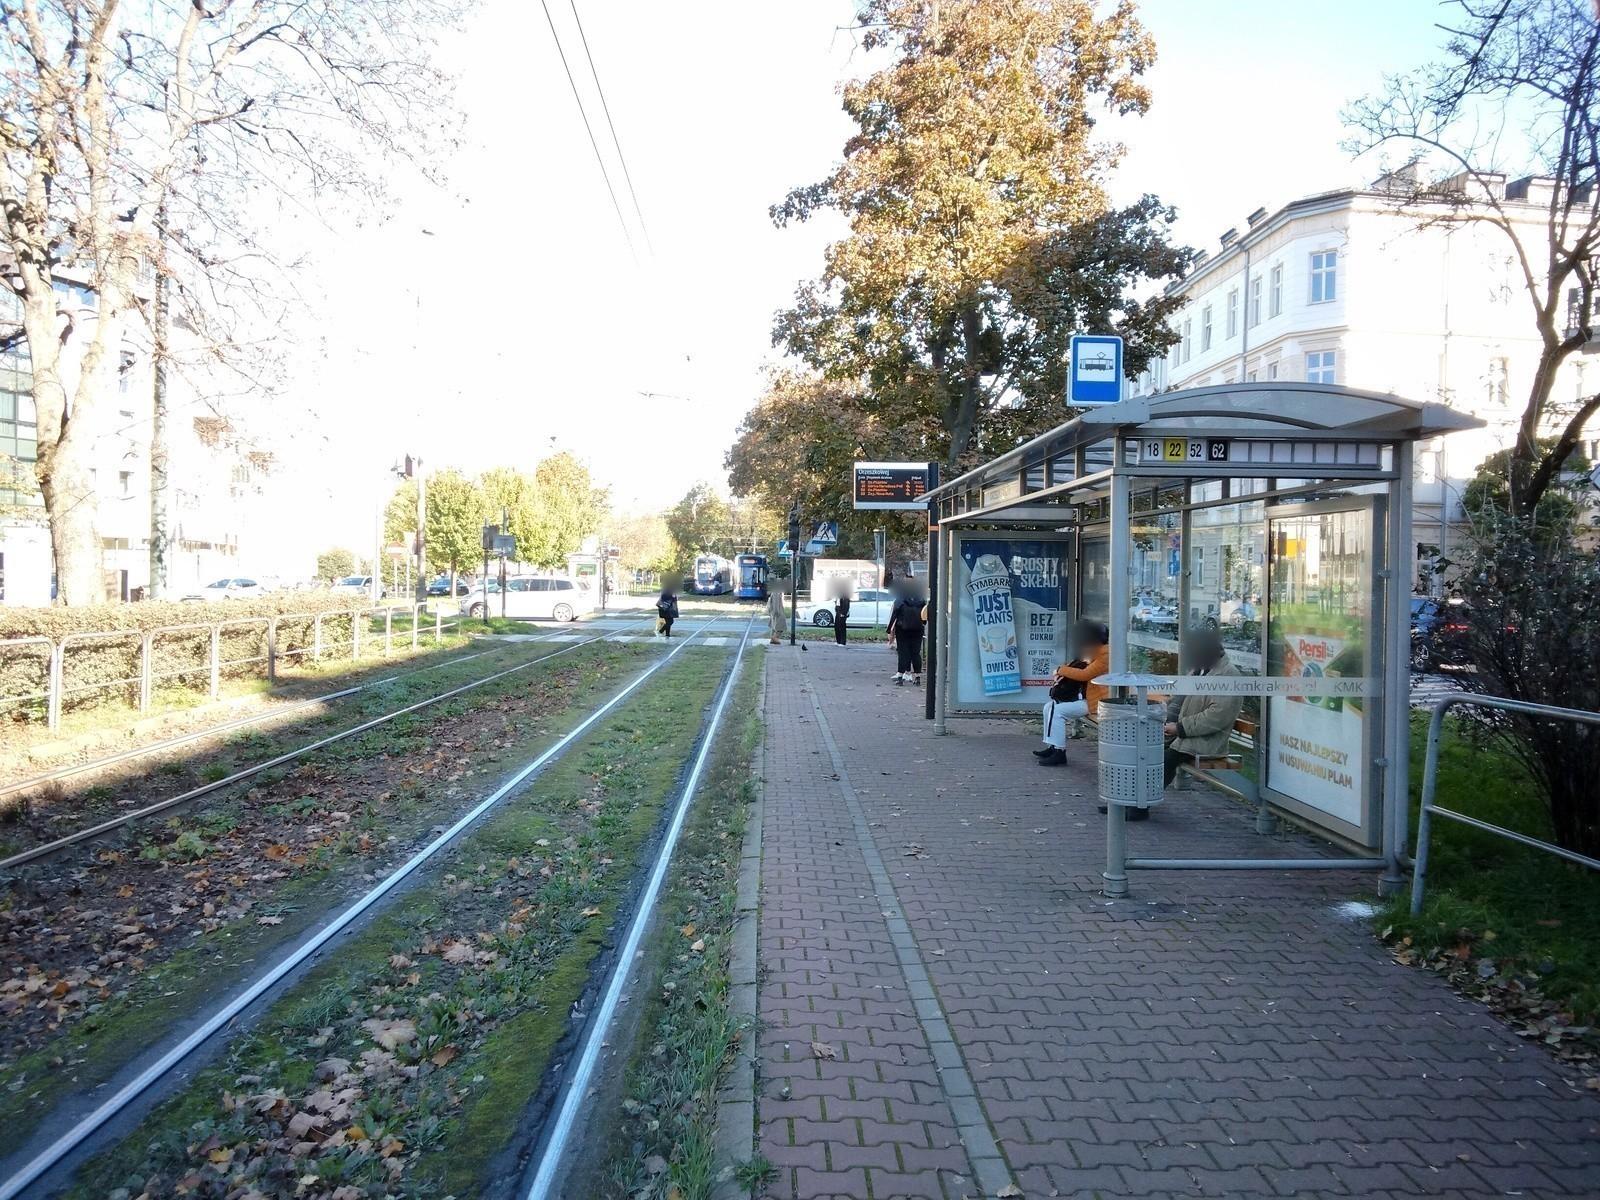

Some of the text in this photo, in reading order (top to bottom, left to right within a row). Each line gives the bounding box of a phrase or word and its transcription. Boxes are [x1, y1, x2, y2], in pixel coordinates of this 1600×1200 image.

[1148, 443, 1224, 458] 18 22 52 62
[970, 577, 1011, 592] TYMBARK
[1021, 574, 1058, 587] SKŁAD
[976, 594, 1010, 613] JUST
[976, 610, 1013, 626] PLANTS
[1030, 613, 1053, 627] BEZ
[1029, 633, 1054, 641] CUKRU
[1299, 638, 1327, 659] Persil
[986, 661, 1015, 673] OWIES
[1334, 681, 1364, 693] KMK
[1280, 733, 1300, 751] NASZ
[1327, 768, 1353, 790] PLAM
